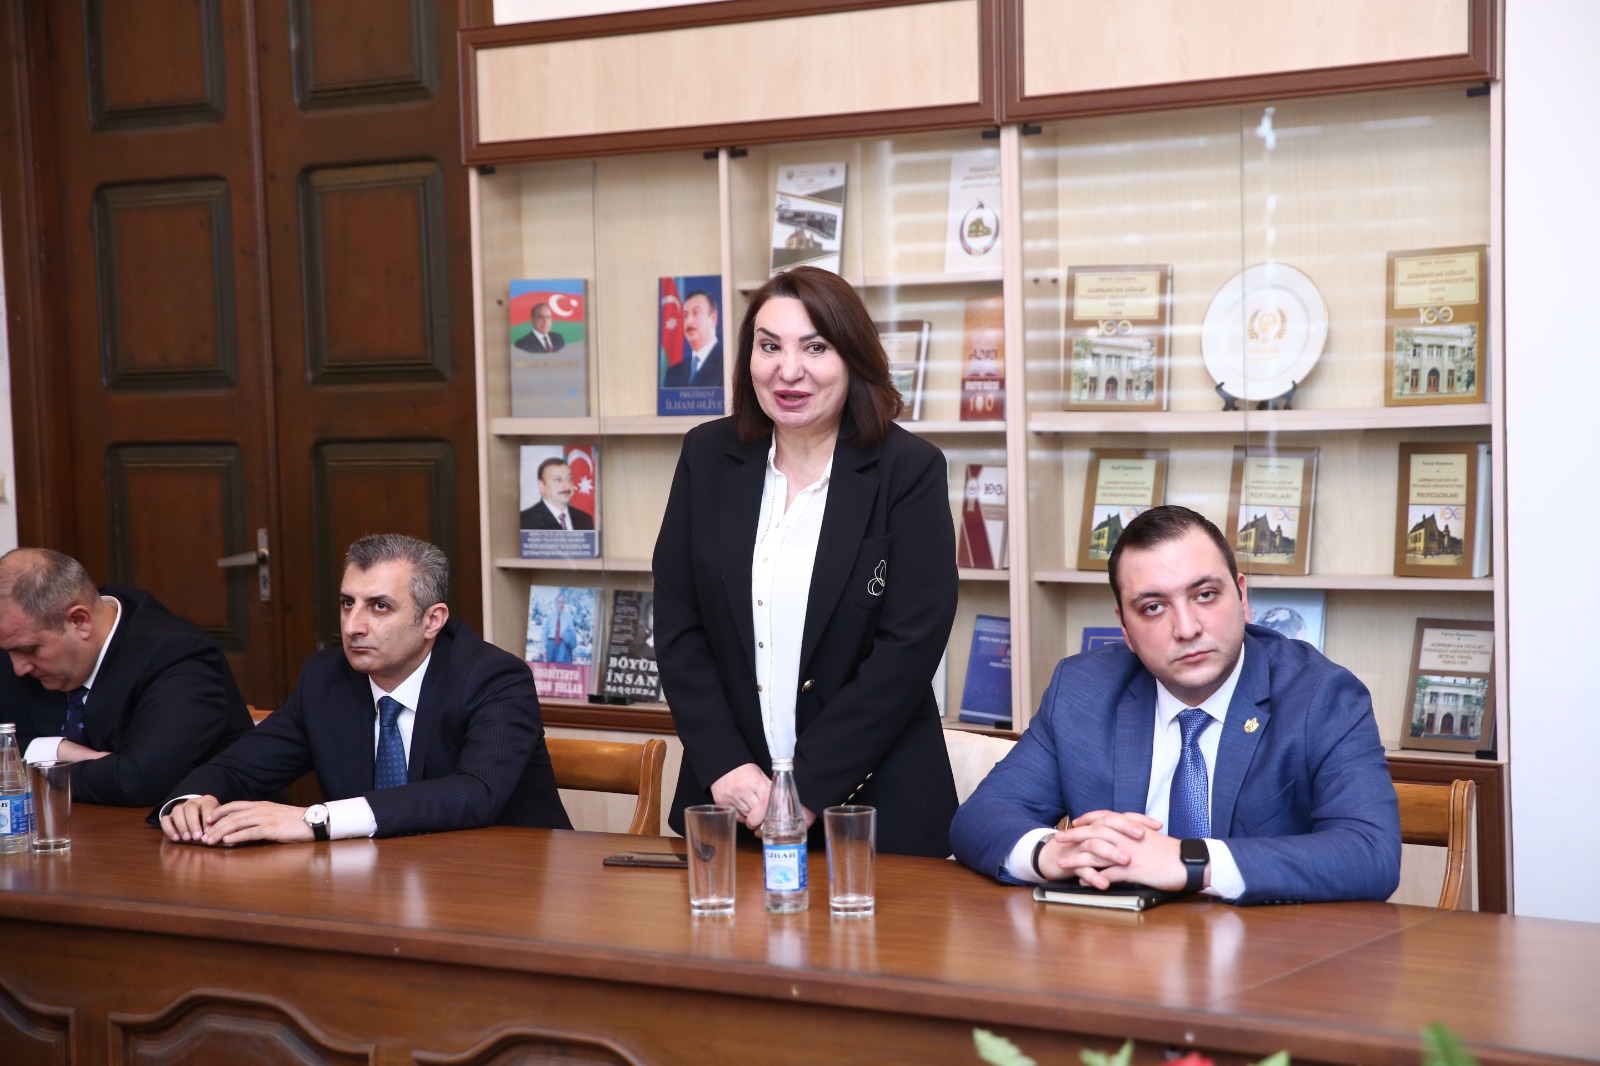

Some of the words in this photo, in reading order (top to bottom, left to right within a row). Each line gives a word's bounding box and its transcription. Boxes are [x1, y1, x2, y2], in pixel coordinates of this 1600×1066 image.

[1419, 305, 1454, 325] 100
[696, 398, 724, 410] ƏLİYE
[606, 669, 659, 687] İNSAN
